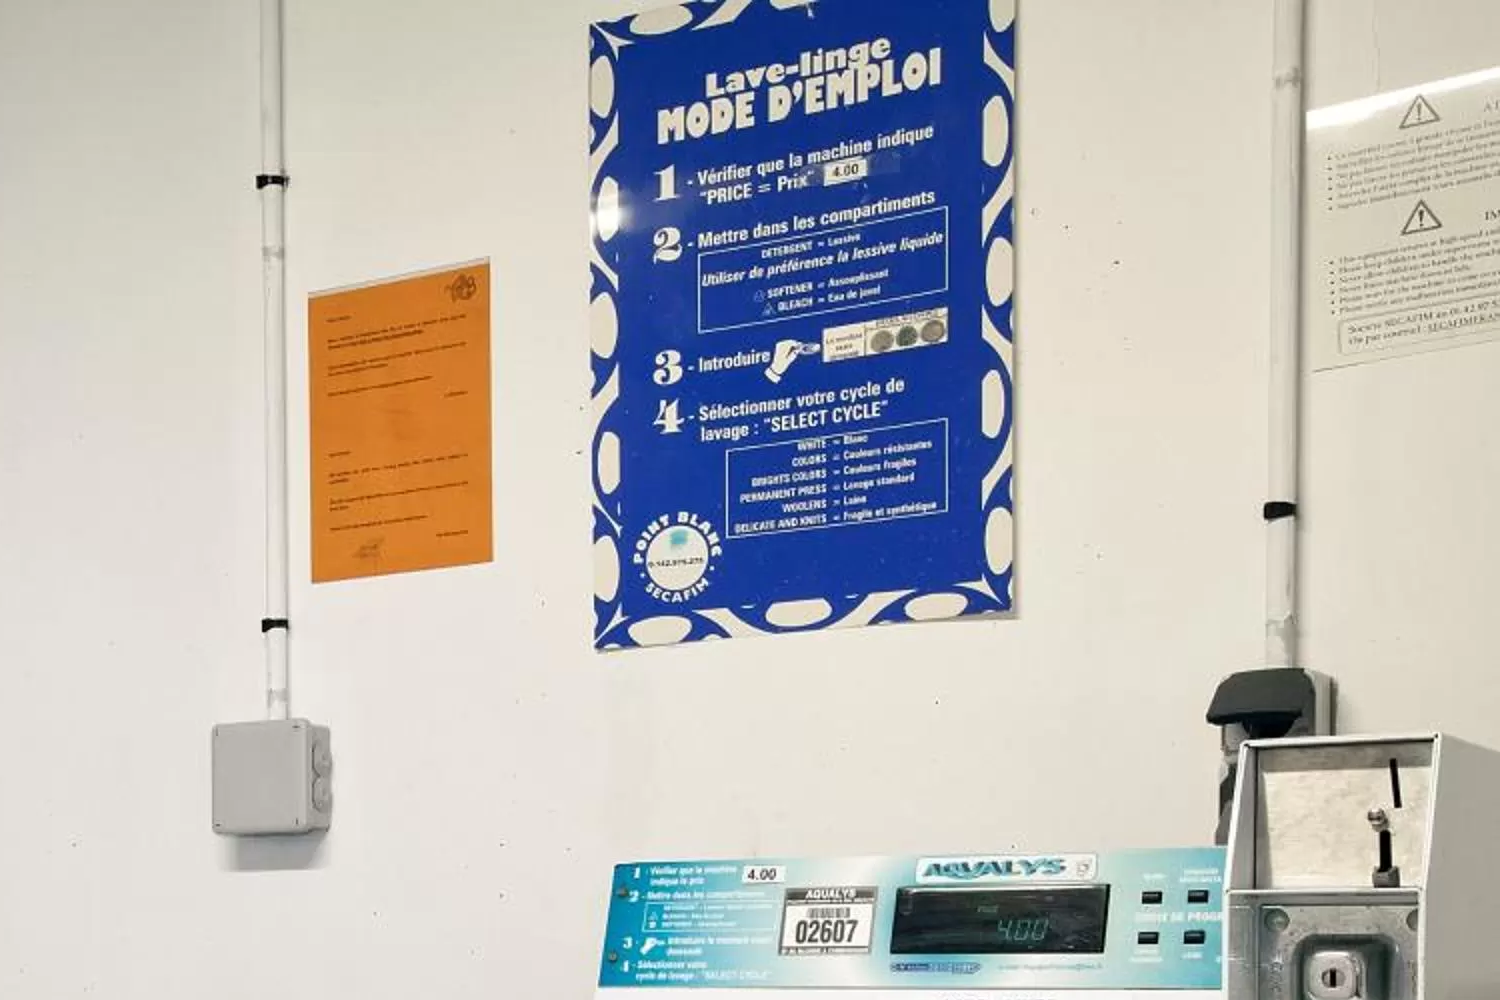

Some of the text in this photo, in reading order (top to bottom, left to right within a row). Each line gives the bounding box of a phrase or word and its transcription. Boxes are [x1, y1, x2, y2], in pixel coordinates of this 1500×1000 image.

[705, 37, 890, 98] Lave-linge
[657, 47, 941, 144] MODE D'EMPLOI
[653, 125, 934, 200] 1 Vérifier que la machine indique
[832, 163, 859, 176] 4.00
[653, 191, 935, 263] 2 Mettre dans les compartiments
[702, 232, 943, 287] Utiliser de préférence la lessive liquide
[653, 350, 770, 386] 3 Introduire
[653, 377, 905, 435] 4 Sélectionner votre cycle de
[701, 422, 749, 443] lavage
[633, 511, 722, 563] POINT BLANC
[778, 517, 798, 529] AND
[644, 577, 709, 603] SECAFIM
[747, 868, 777, 881] 4.00
[805, 888, 857, 899] AQUALYS
[795, 919, 858, 943] 02607
